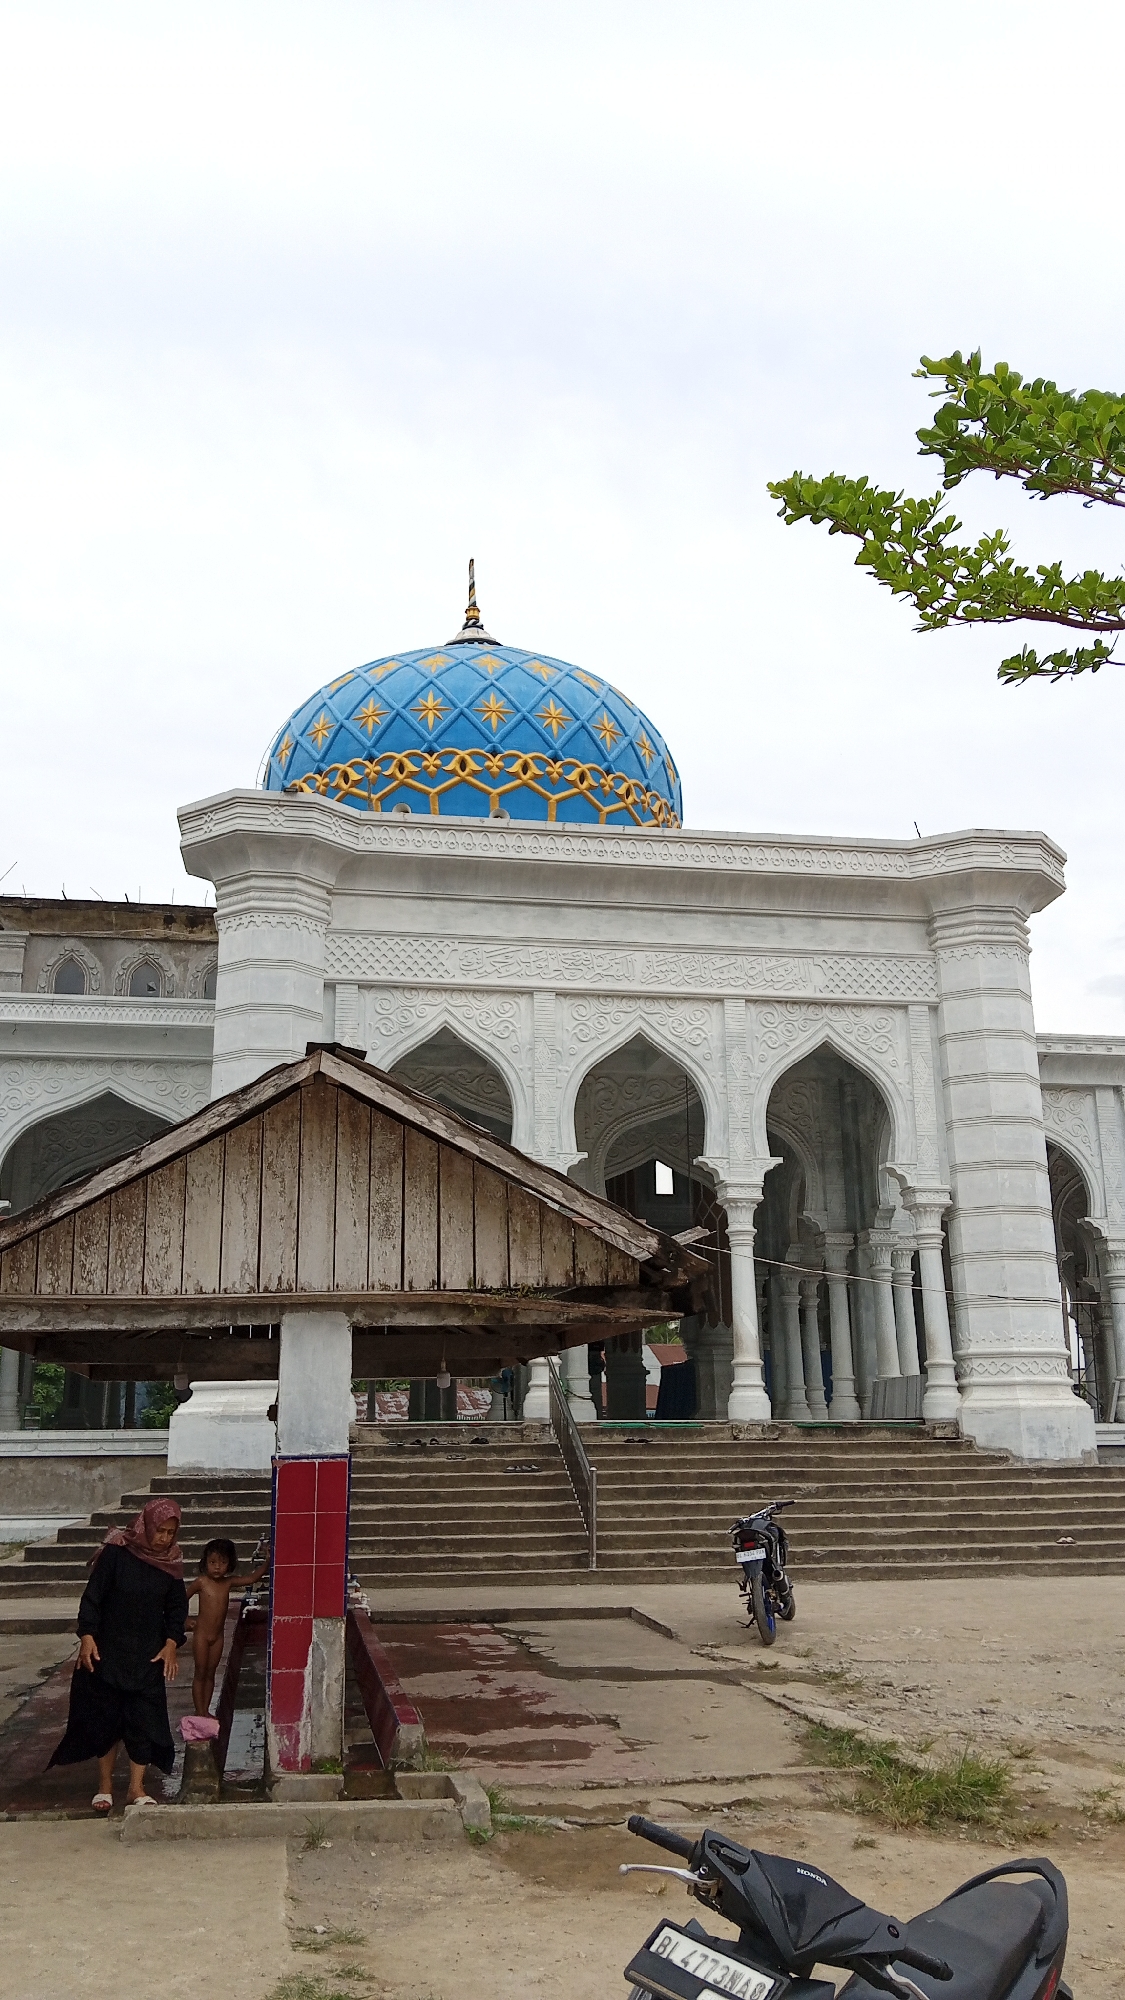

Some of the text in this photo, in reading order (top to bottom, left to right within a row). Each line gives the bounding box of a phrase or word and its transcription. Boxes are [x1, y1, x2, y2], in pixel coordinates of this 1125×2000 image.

[796, 1867, 828, 1886] HONDA
[655, 1935, 678, 1961] BL
[681, 1949, 730, 1984] 4773
